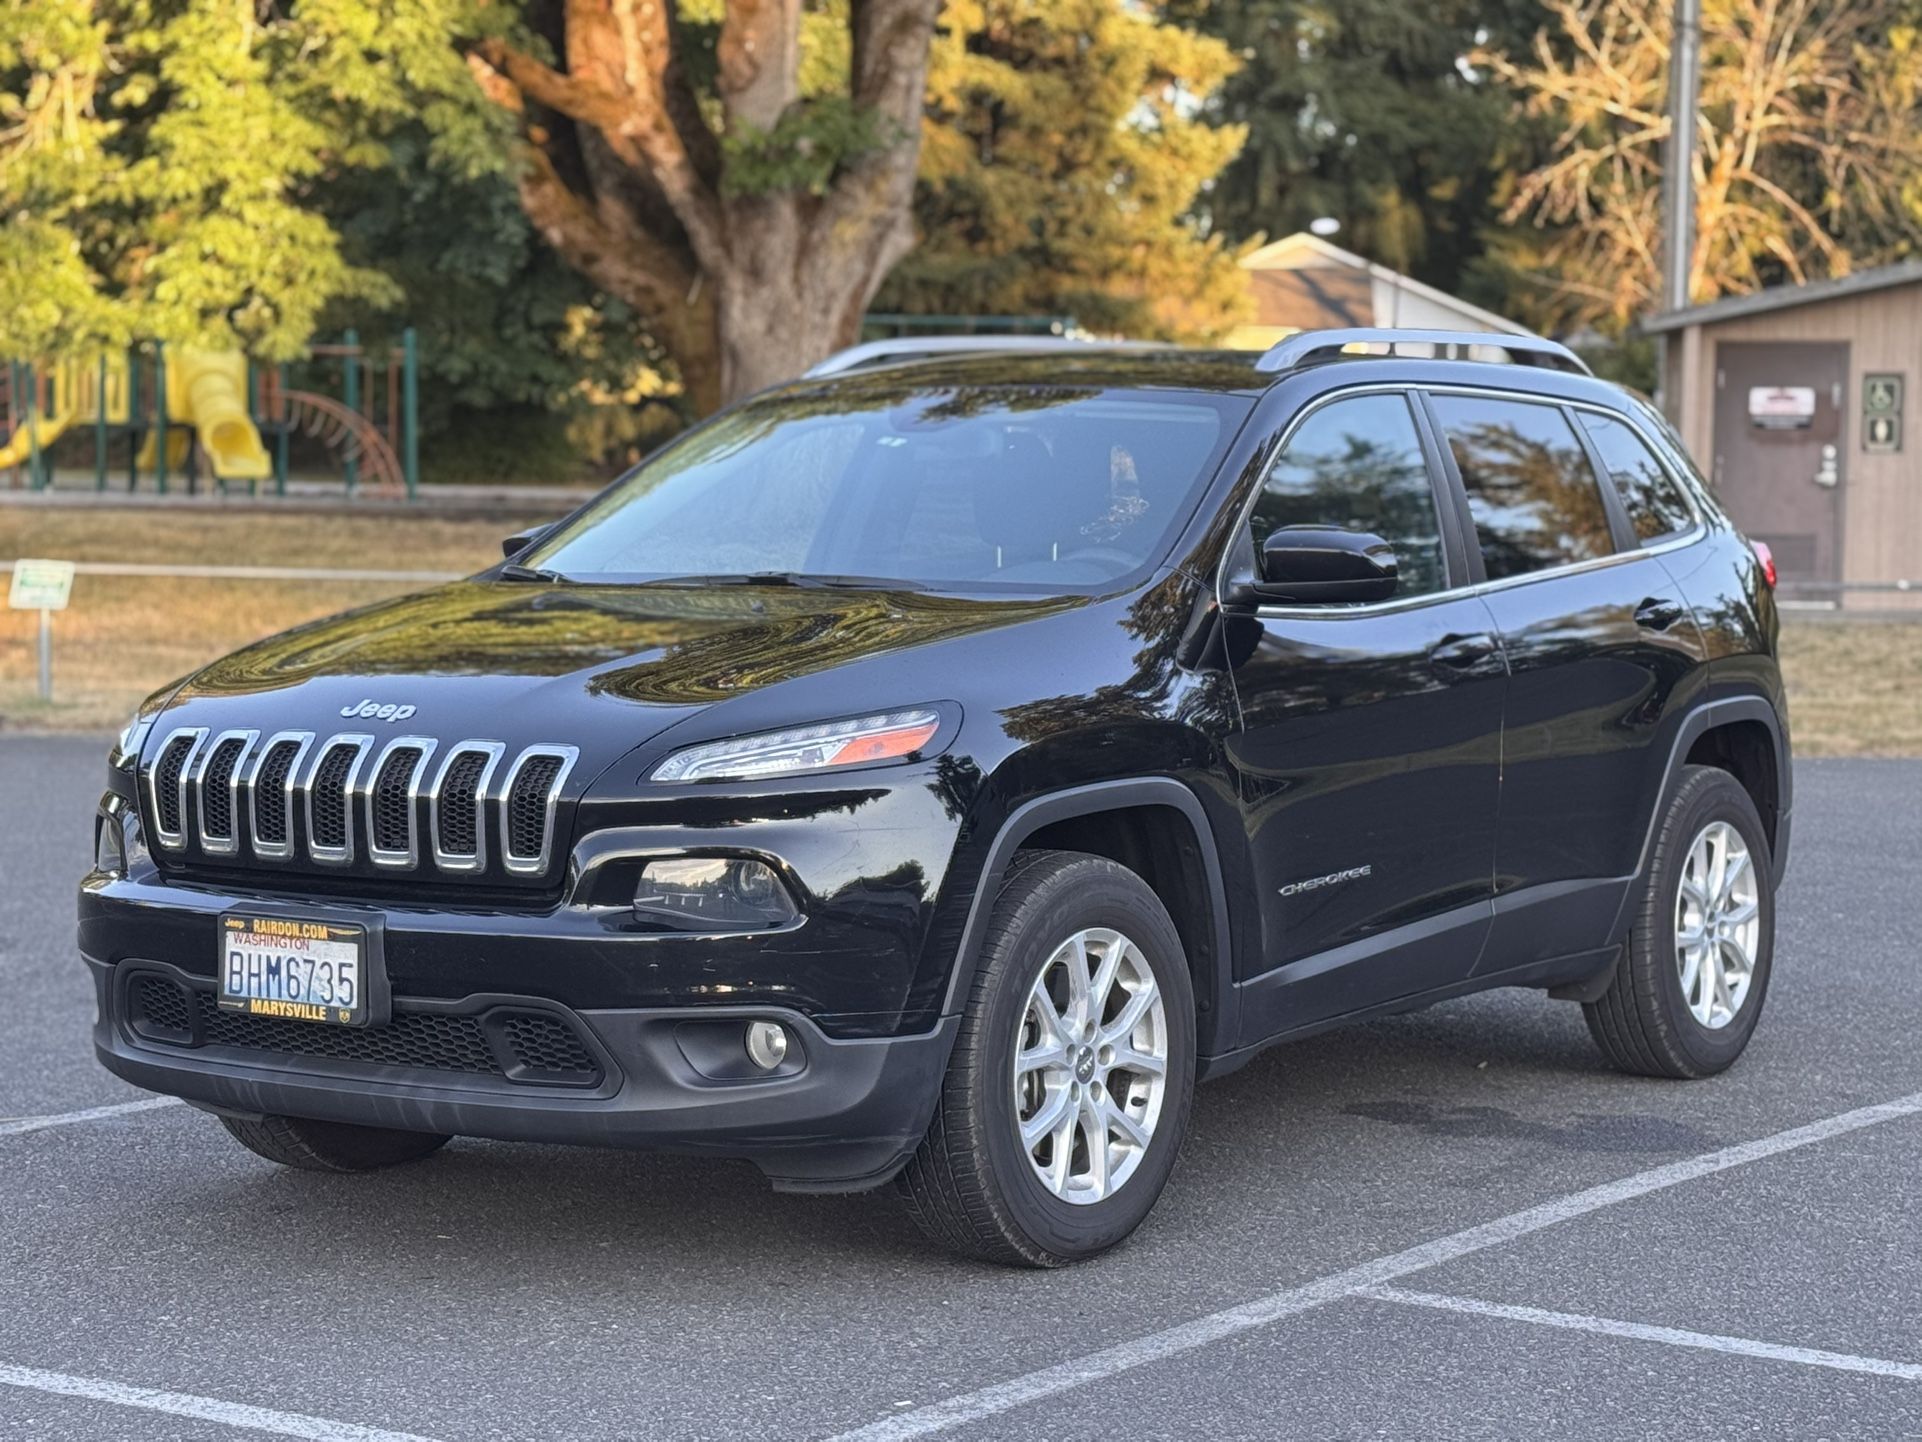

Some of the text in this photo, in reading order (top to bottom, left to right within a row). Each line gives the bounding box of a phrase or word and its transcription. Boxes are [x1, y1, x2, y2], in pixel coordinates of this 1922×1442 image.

[340, 699, 417, 723] Jeep
[1278, 865, 1371, 896] CHEROKEE
[253, 919, 328, 939] RAIRDON.COM
[233, 931, 310, 951] WASHINGTON
[229, 951, 354, 1006] BHM6735
[251, 999, 327, 1020] MARYSVILLE
